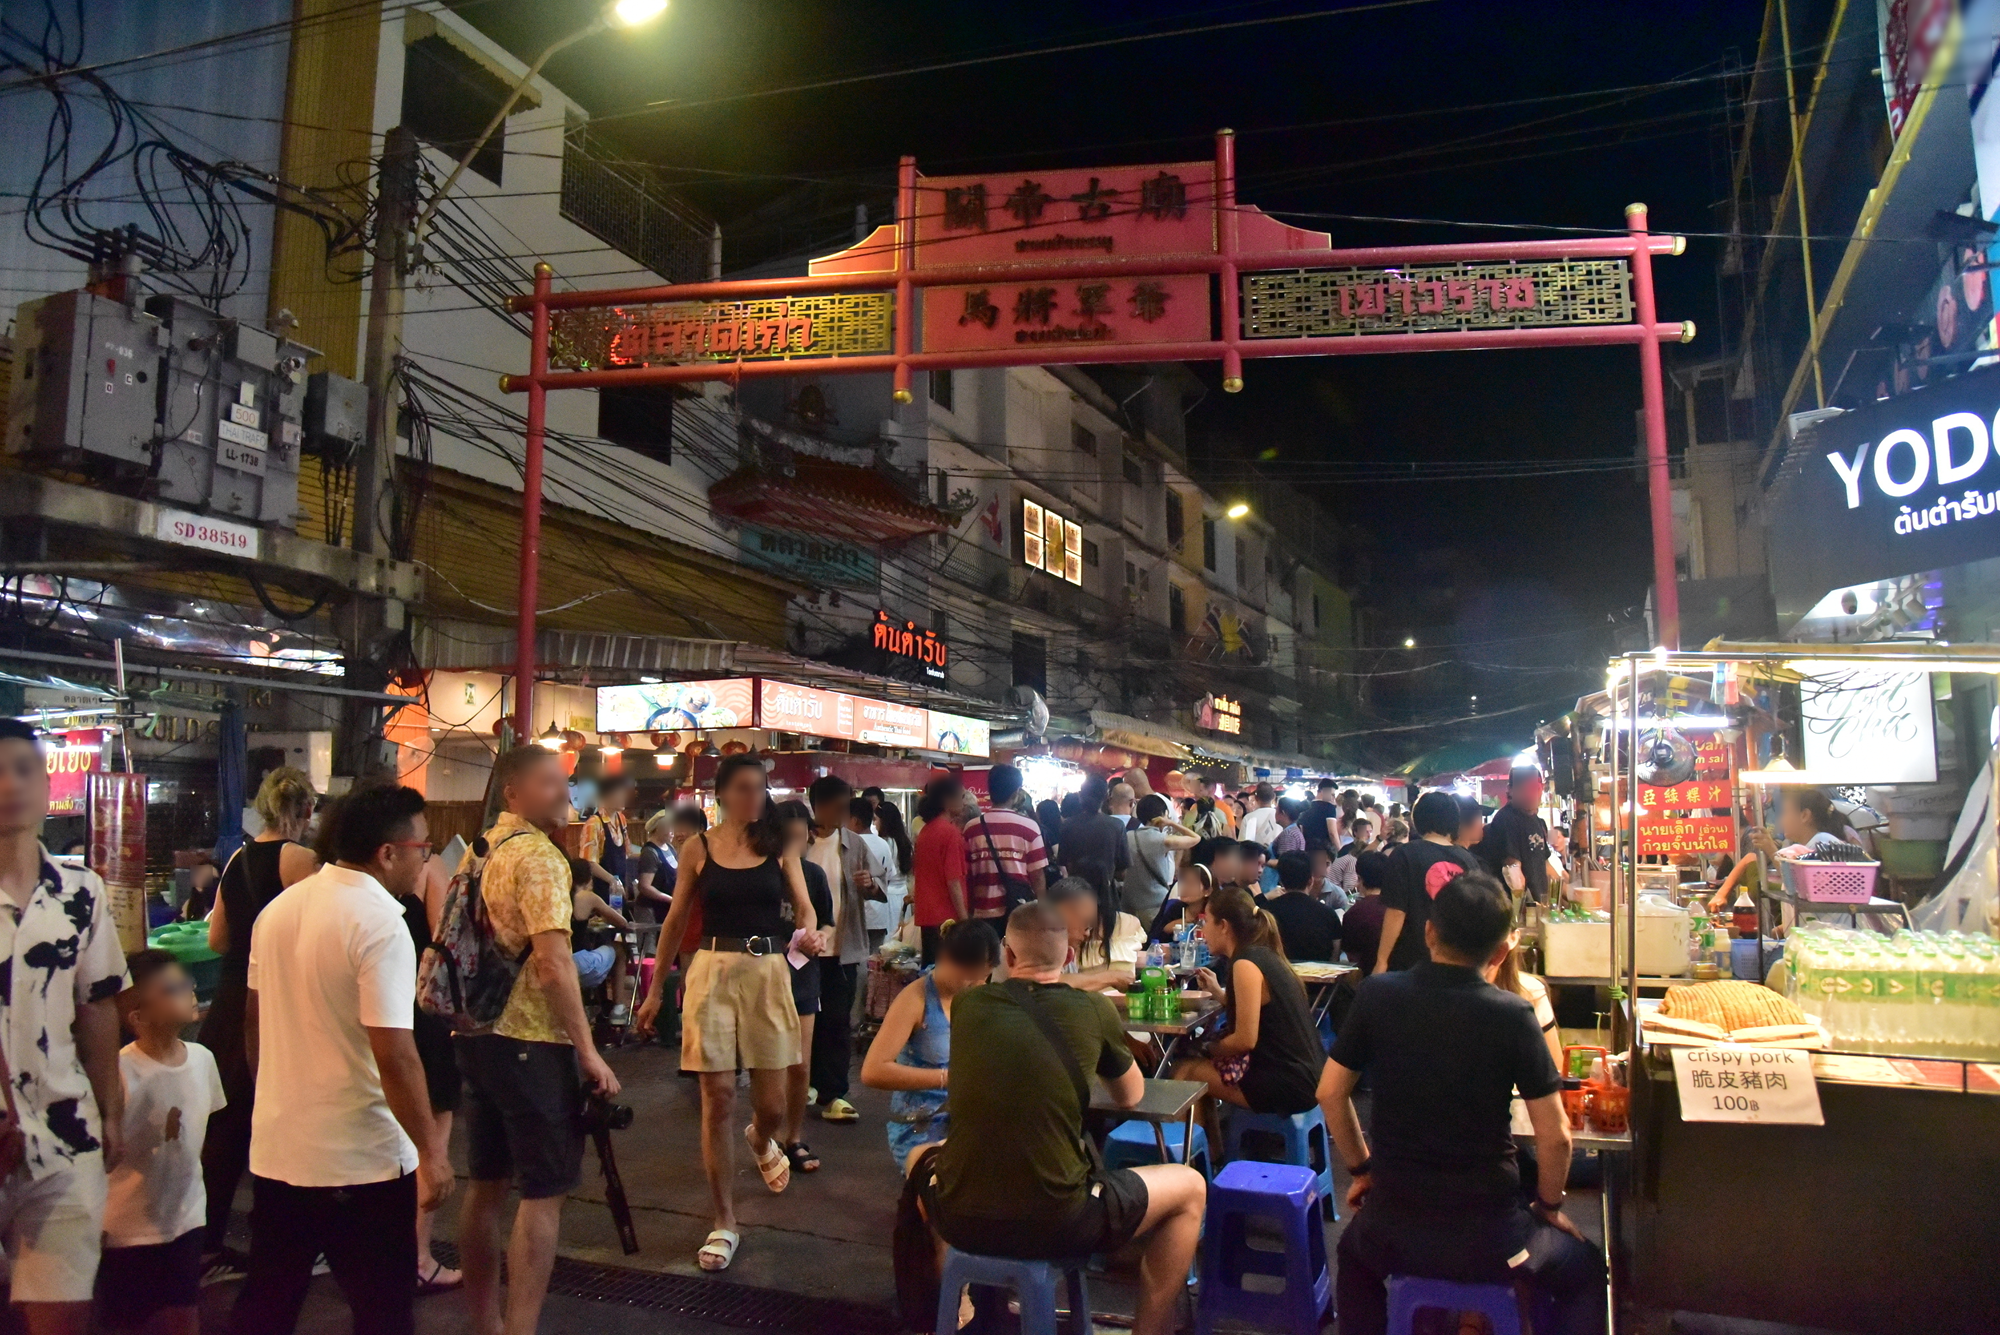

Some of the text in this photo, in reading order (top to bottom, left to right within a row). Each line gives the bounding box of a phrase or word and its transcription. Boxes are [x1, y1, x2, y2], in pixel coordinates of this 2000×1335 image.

[1336, 277, 1538, 317] เยาวราช
[620, 303, 814, 357] ตลาดเก่า
[235, 409, 256, 424] 500
[221, 424, 267, 448] THAI TRAFO
[1826, 407, 2000, 509] YOD
[199, 526, 247, 549] 38519
[874, 610, 946, 667] ต้นตำรับ
[64, 694, 101, 705] ตลาดเก่
[776, 686, 823, 720] ต้นตำรับ
[1708, 754, 1724, 763] sai
[1639, 820, 1729, 836] นายเล็ก (อ้วน)
[1687, 1048, 1795, 1066] crispy pork
[1692, 1069, 1788, 1090] 脆皮豬肉
